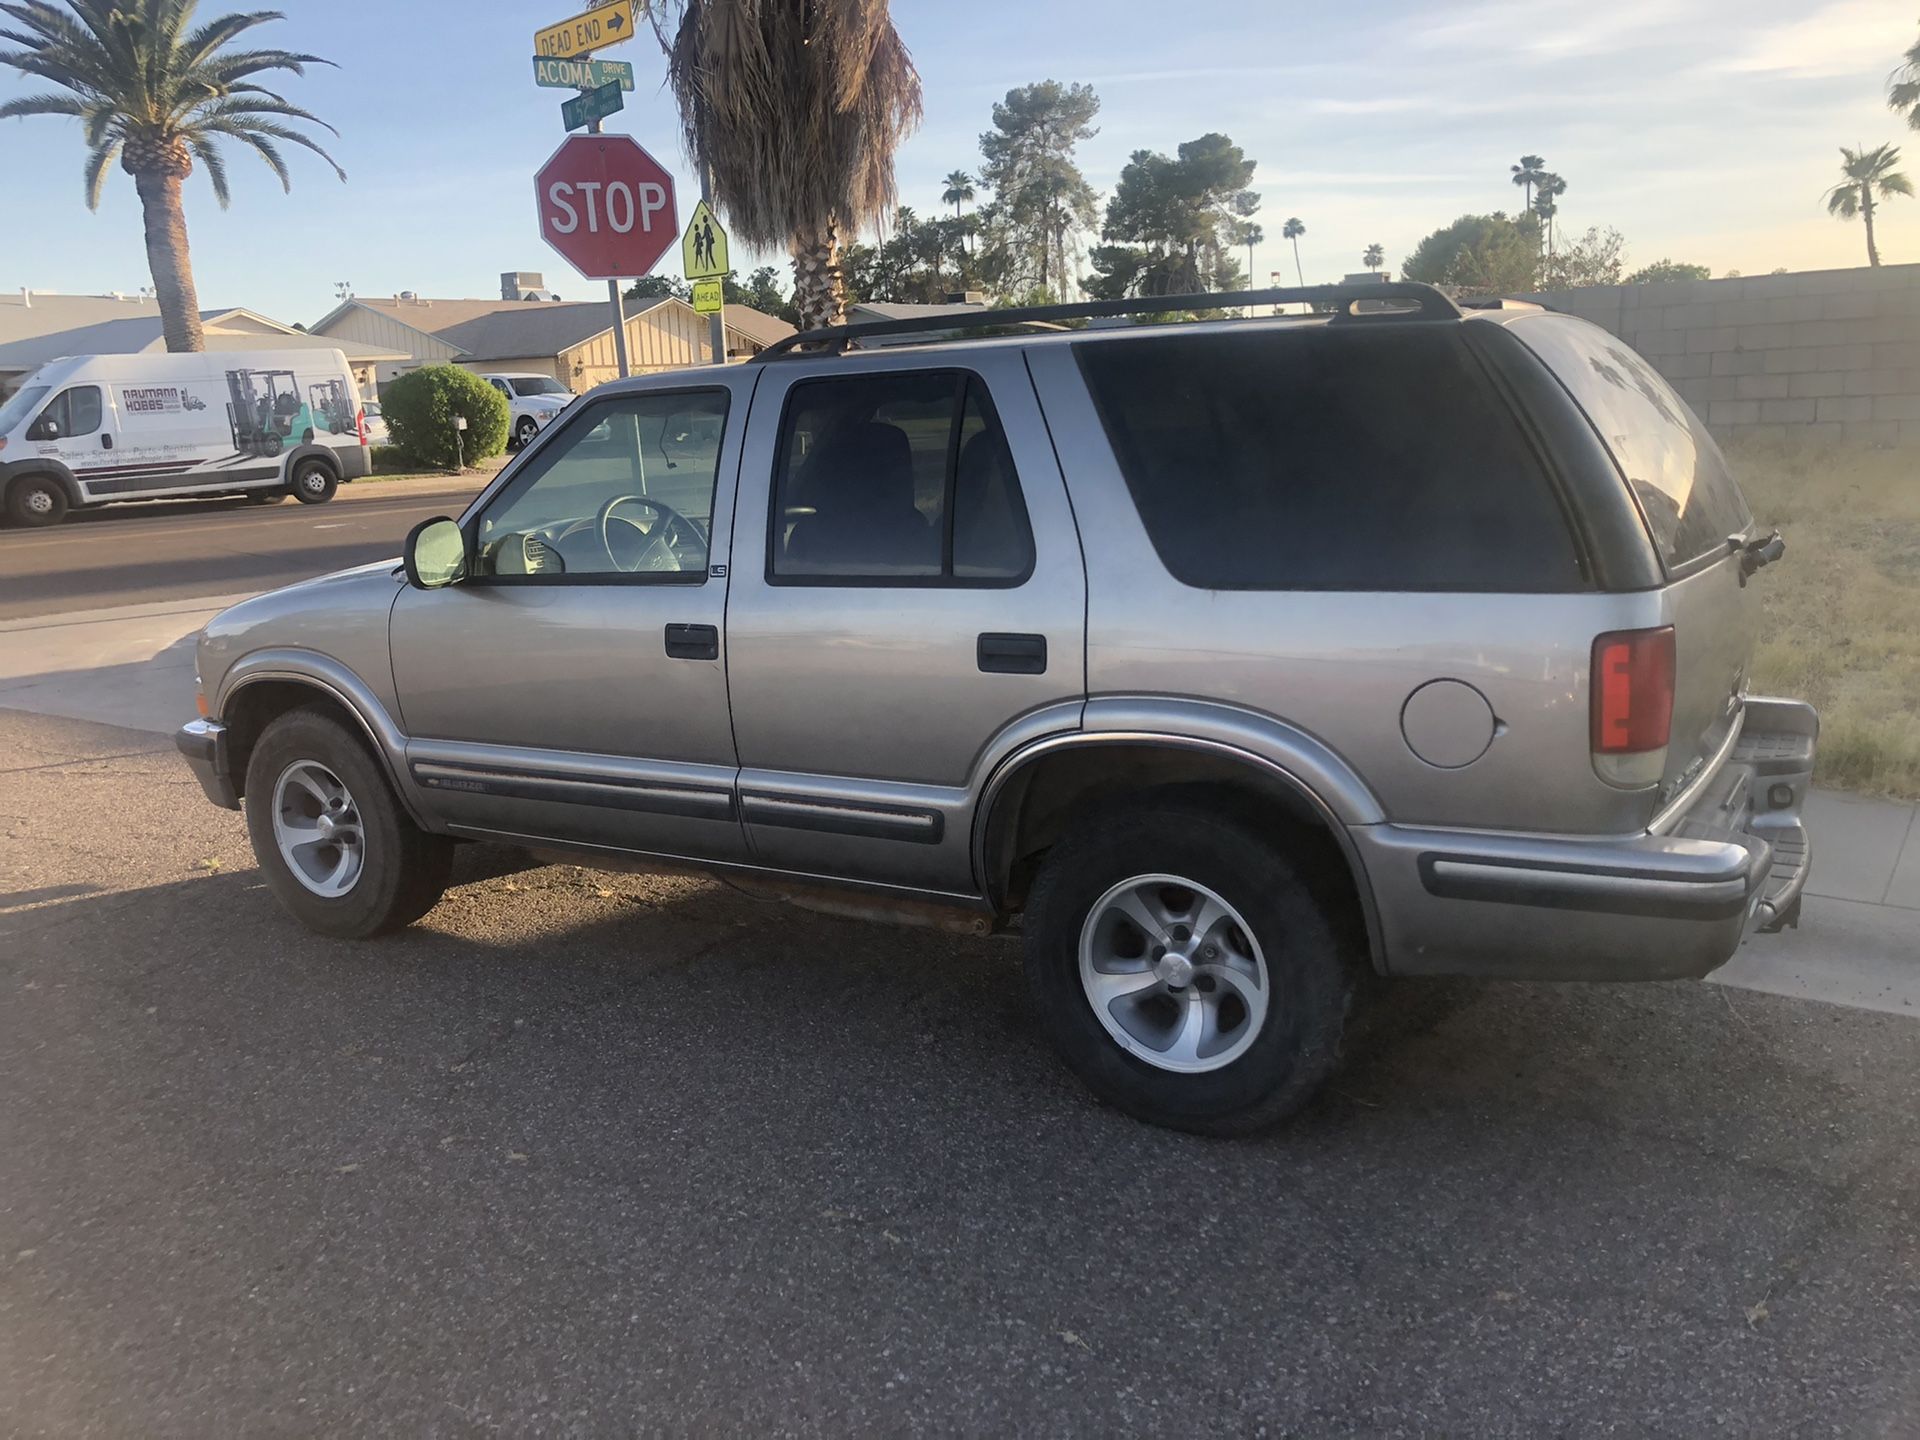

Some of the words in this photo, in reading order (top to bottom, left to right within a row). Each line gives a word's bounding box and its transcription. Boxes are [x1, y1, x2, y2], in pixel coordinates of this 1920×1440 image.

[541, 30, 571, 56] DEAD
[576, 18, 601, 46] END
[538, 60, 595, 85] ACOMA
[602, 62, 626, 75] DRIVE
[549, 181, 666, 234] STOP
[696, 291, 719, 302] AHEAD
[123, 388, 178, 399] NAUMANN
[125, 400, 164, 411] HOBBS
[59, 451, 85, 460] Sales
[711, 566, 726, 576] LS
